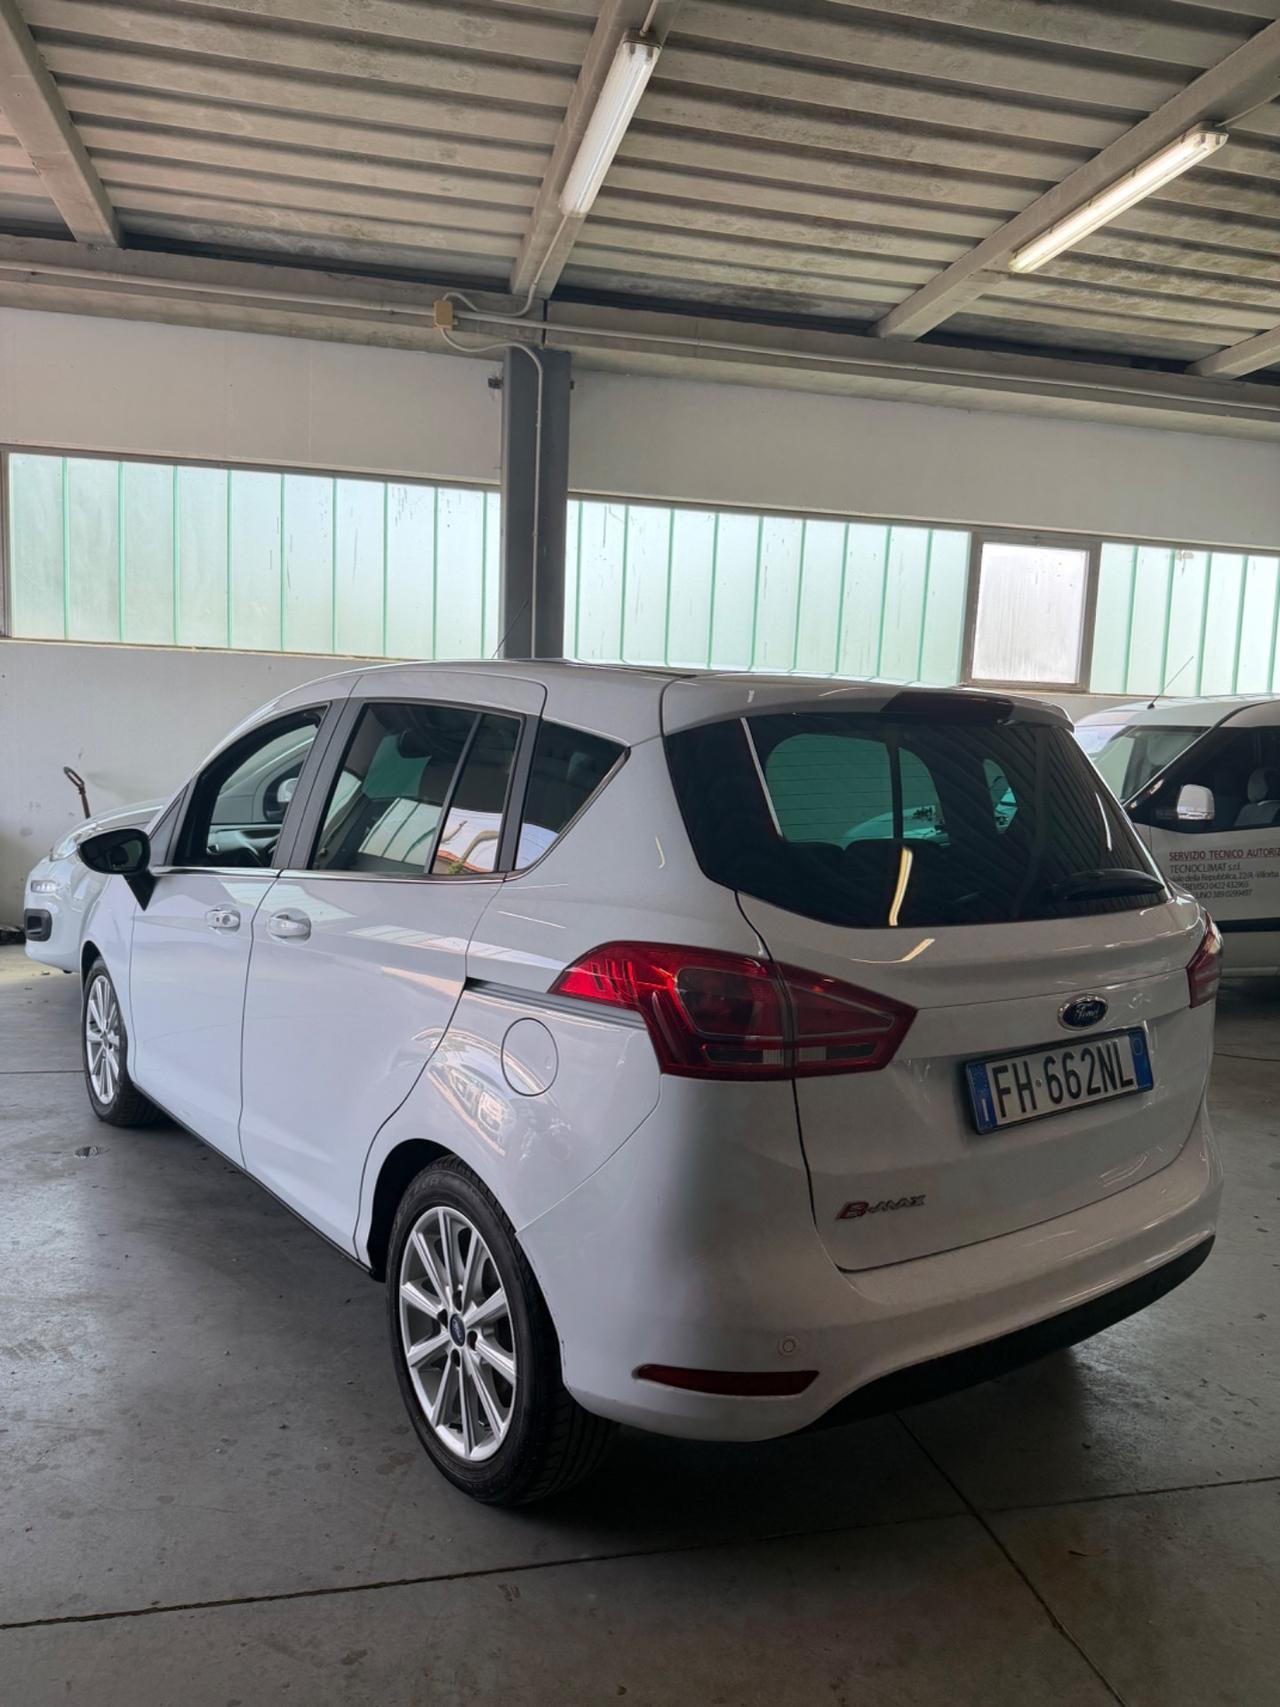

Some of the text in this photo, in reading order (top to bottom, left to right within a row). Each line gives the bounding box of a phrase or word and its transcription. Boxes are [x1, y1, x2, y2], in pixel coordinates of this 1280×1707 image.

[1168, 851, 1206, 861] SERVIZIO
[1209, 849, 1244, 860] TECNICO
[1170, 863, 1226, 874] TECNOCLIMAT
